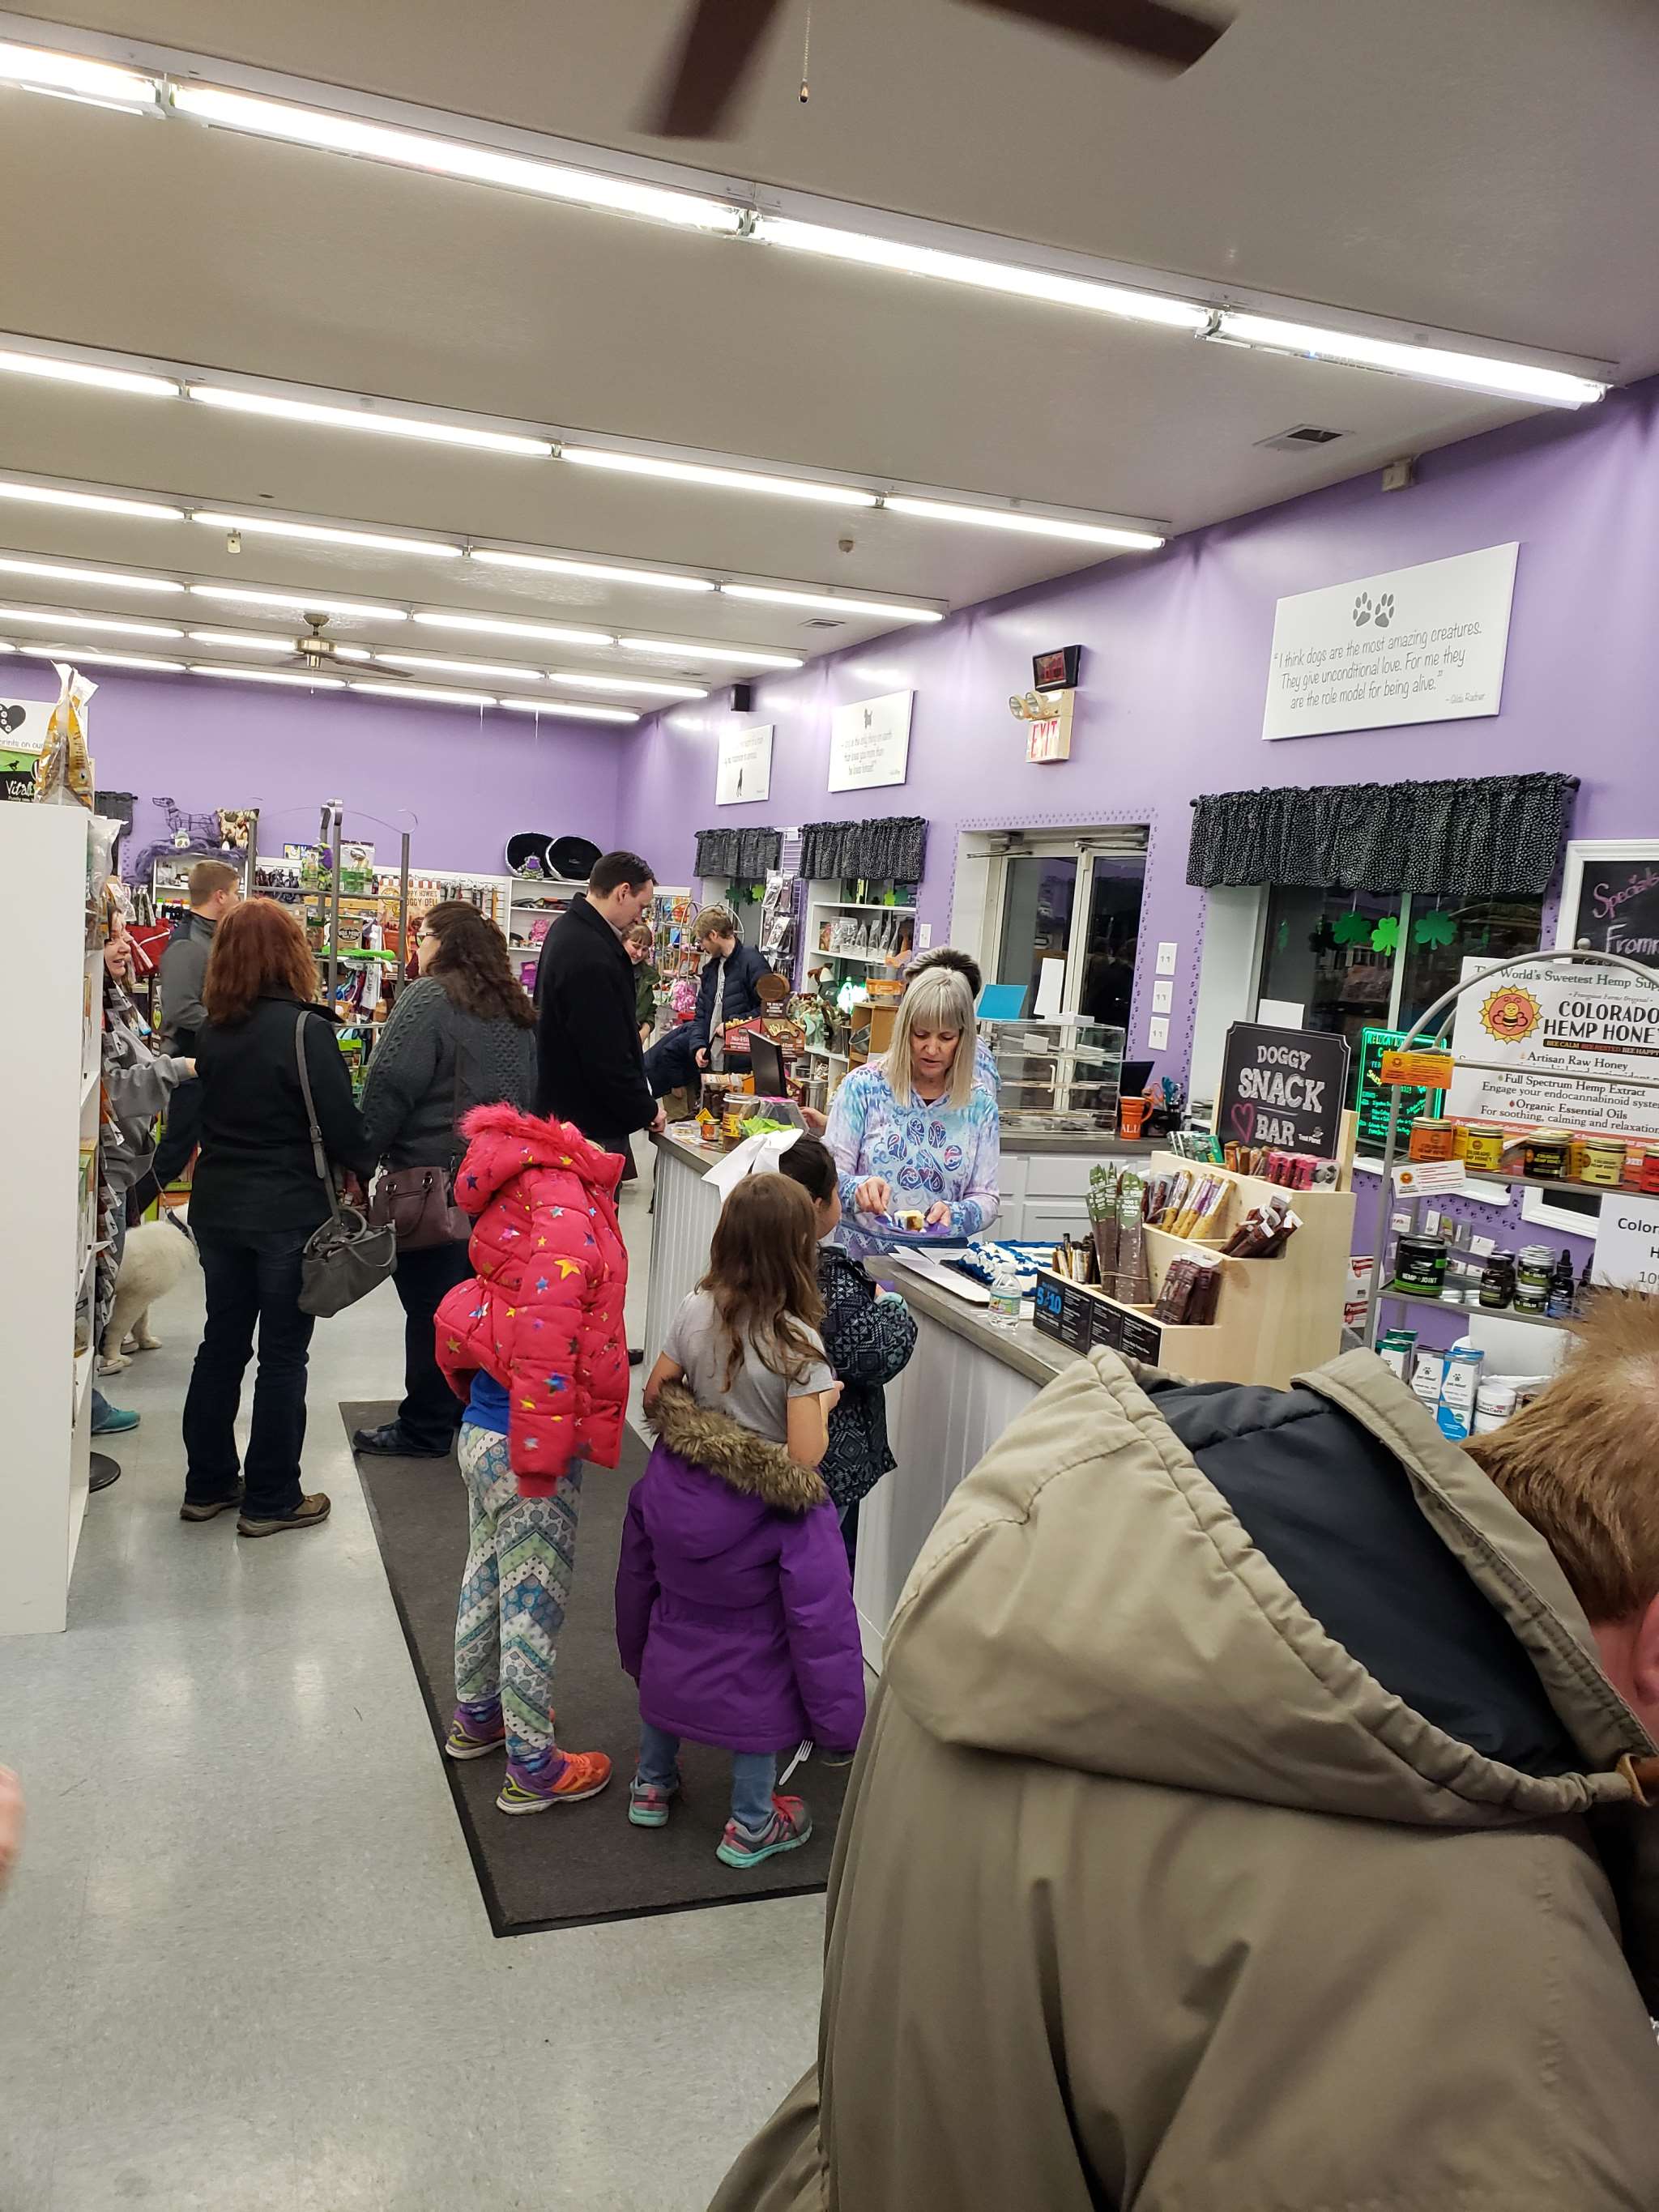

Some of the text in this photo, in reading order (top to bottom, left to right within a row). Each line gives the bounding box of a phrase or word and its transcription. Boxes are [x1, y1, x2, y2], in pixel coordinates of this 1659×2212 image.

[1286, 648, 1305, 667] think
[1307, 646, 1327, 667] dogs
[1329, 647, 1343, 660] are
[1346, 640, 1360, 657] the
[1362, 637, 1385, 654] most
[1388, 630, 1427, 649] amazing
[1431, 621, 1482, 642] creatures.
[1282, 645, 1465, 692] They give unconditional love. For me they
[1290, 697, 1304, 709] are
[1307, 690, 1320, 706] the
[1321, 687, 1337, 705] role
[1339, 682, 1367, 702] model
[1368, 680, 1382, 698] for
[1384, 679, 1410, 699] being
[1499, 968, 1542, 981] World's
[1544, 970, 1593, 984] Sweetest
[1596, 974, 1631, 989] Hemp
[1559, 1000, 1659, 1025] COLORADO
[1543, 1018, 1659, 1044] HEMP HONE
[1256, 1045, 1311, 1071] DOGGY
[1527, 1051, 1564, 1064] Artisan
[1568, 1055, 1591, 1067] Raw
[1594, 1058, 1629, 1072] Honey
[1238, 1068, 1325, 1114] SNACK
[1482, 1081, 1659, 1109] Engage your endocannabinoid syste
[1504, 1073, 1646, 1097] Full Spectrum Hemp Extract
[1481, 1105, 1498, 1116] For
[1499, 1110, 1545, 1123] soothing,
[1547, 1114, 1587, 1127] calming
[1589, 1119, 1609, 1128] and
[1516, 1099, 1627, 1119] Organic Essential Oils
[1255, 1114, 1294, 1147] BAR
